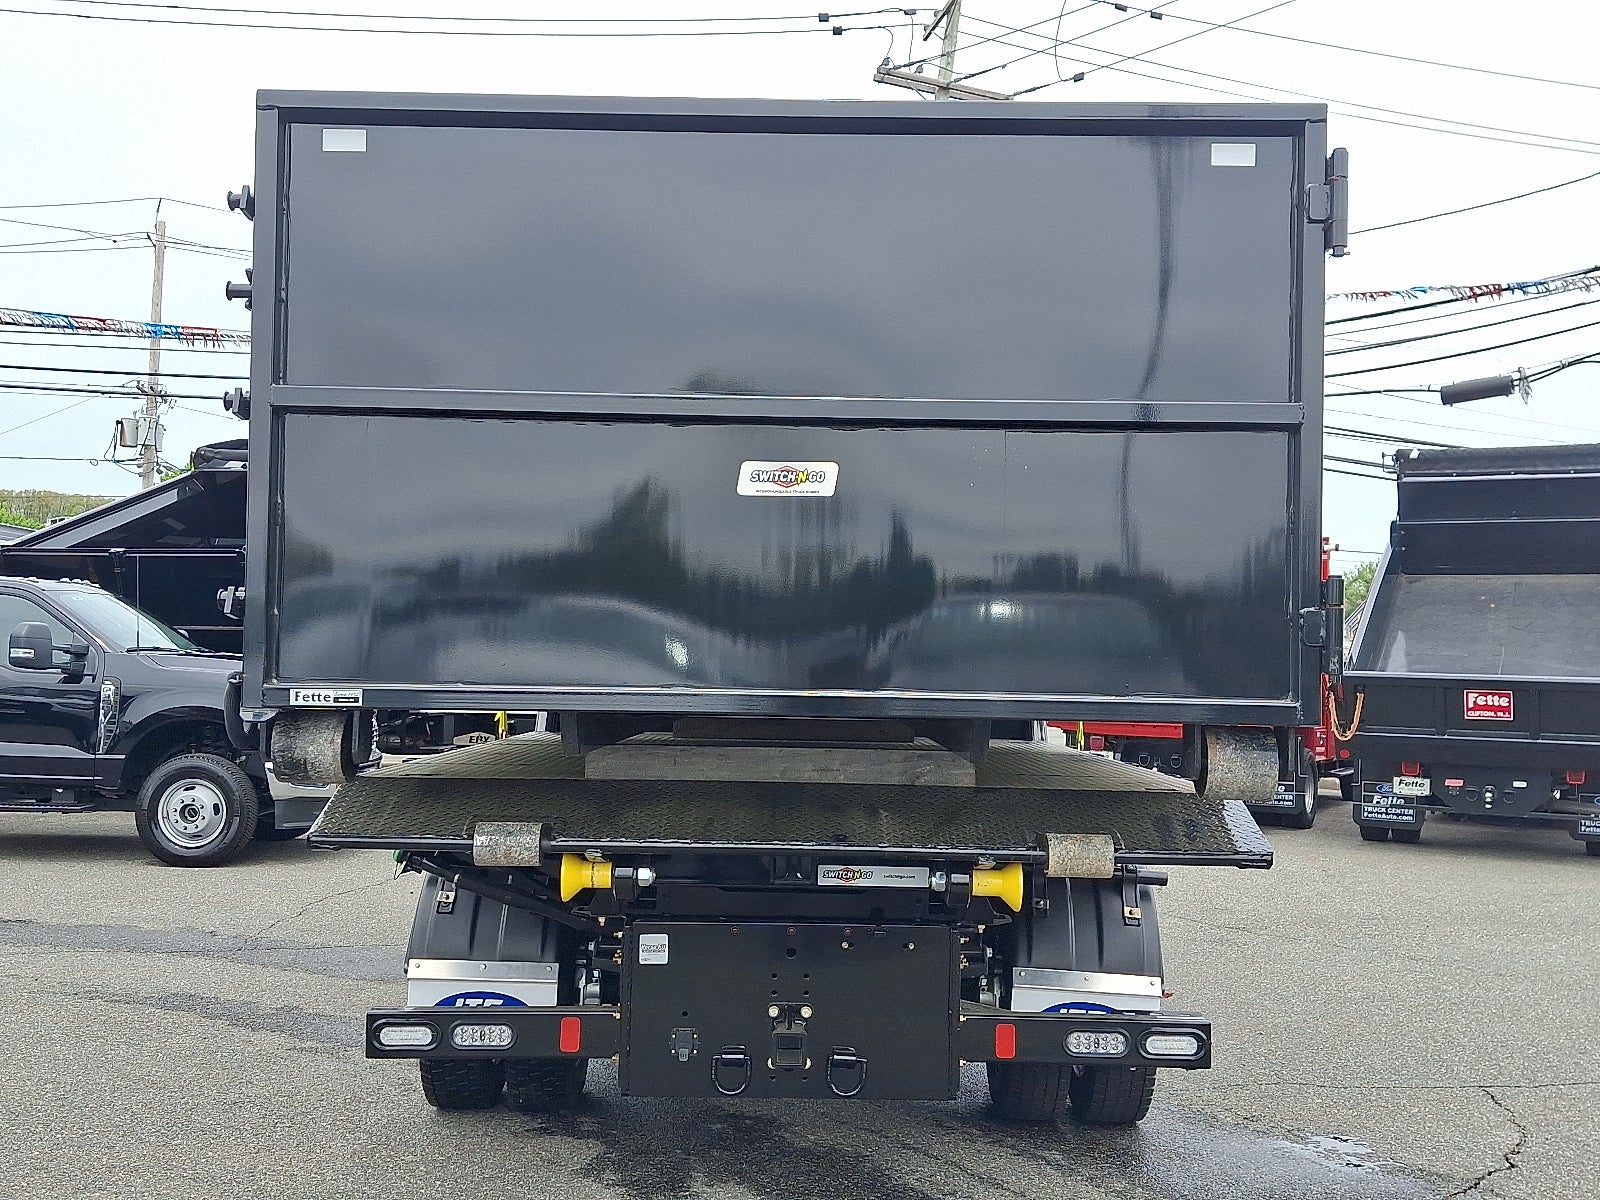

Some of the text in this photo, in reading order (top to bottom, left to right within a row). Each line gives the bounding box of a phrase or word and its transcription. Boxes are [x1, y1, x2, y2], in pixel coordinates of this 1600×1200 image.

[294, 691, 332, 703] Fette
[1468, 692, 1510, 709] Fette
[1387, 807, 1414, 815] CENTER
